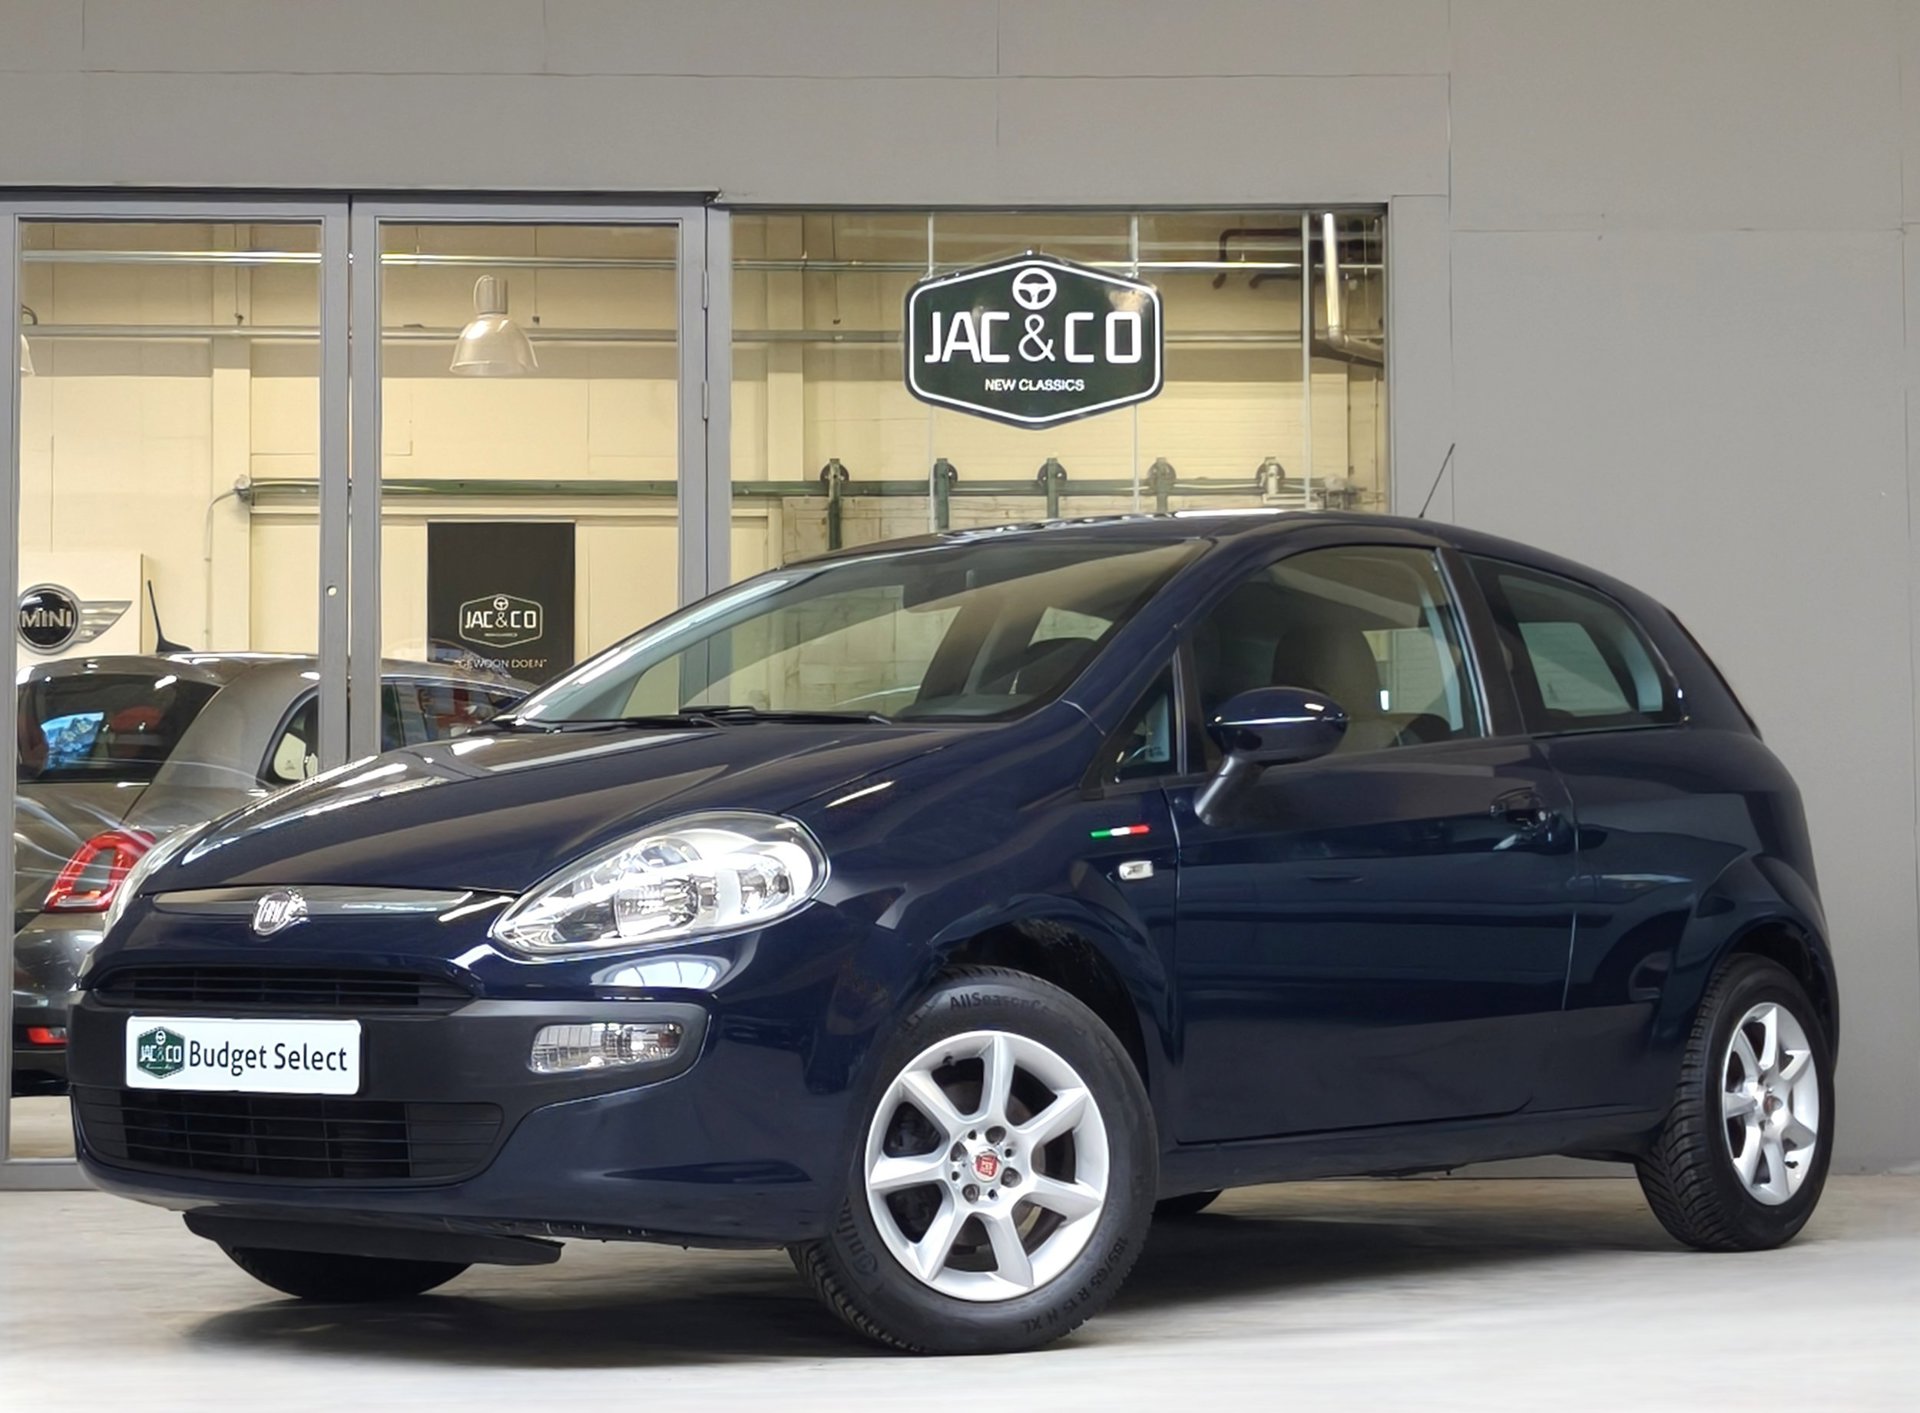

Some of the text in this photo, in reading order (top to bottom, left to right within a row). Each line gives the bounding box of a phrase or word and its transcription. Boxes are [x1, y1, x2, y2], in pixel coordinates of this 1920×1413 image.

[984, 378, 1085, 391] NEW CLASSICS
[21, 608, 72, 628] MINI
[189, 1040, 348, 1076] Budget Select
